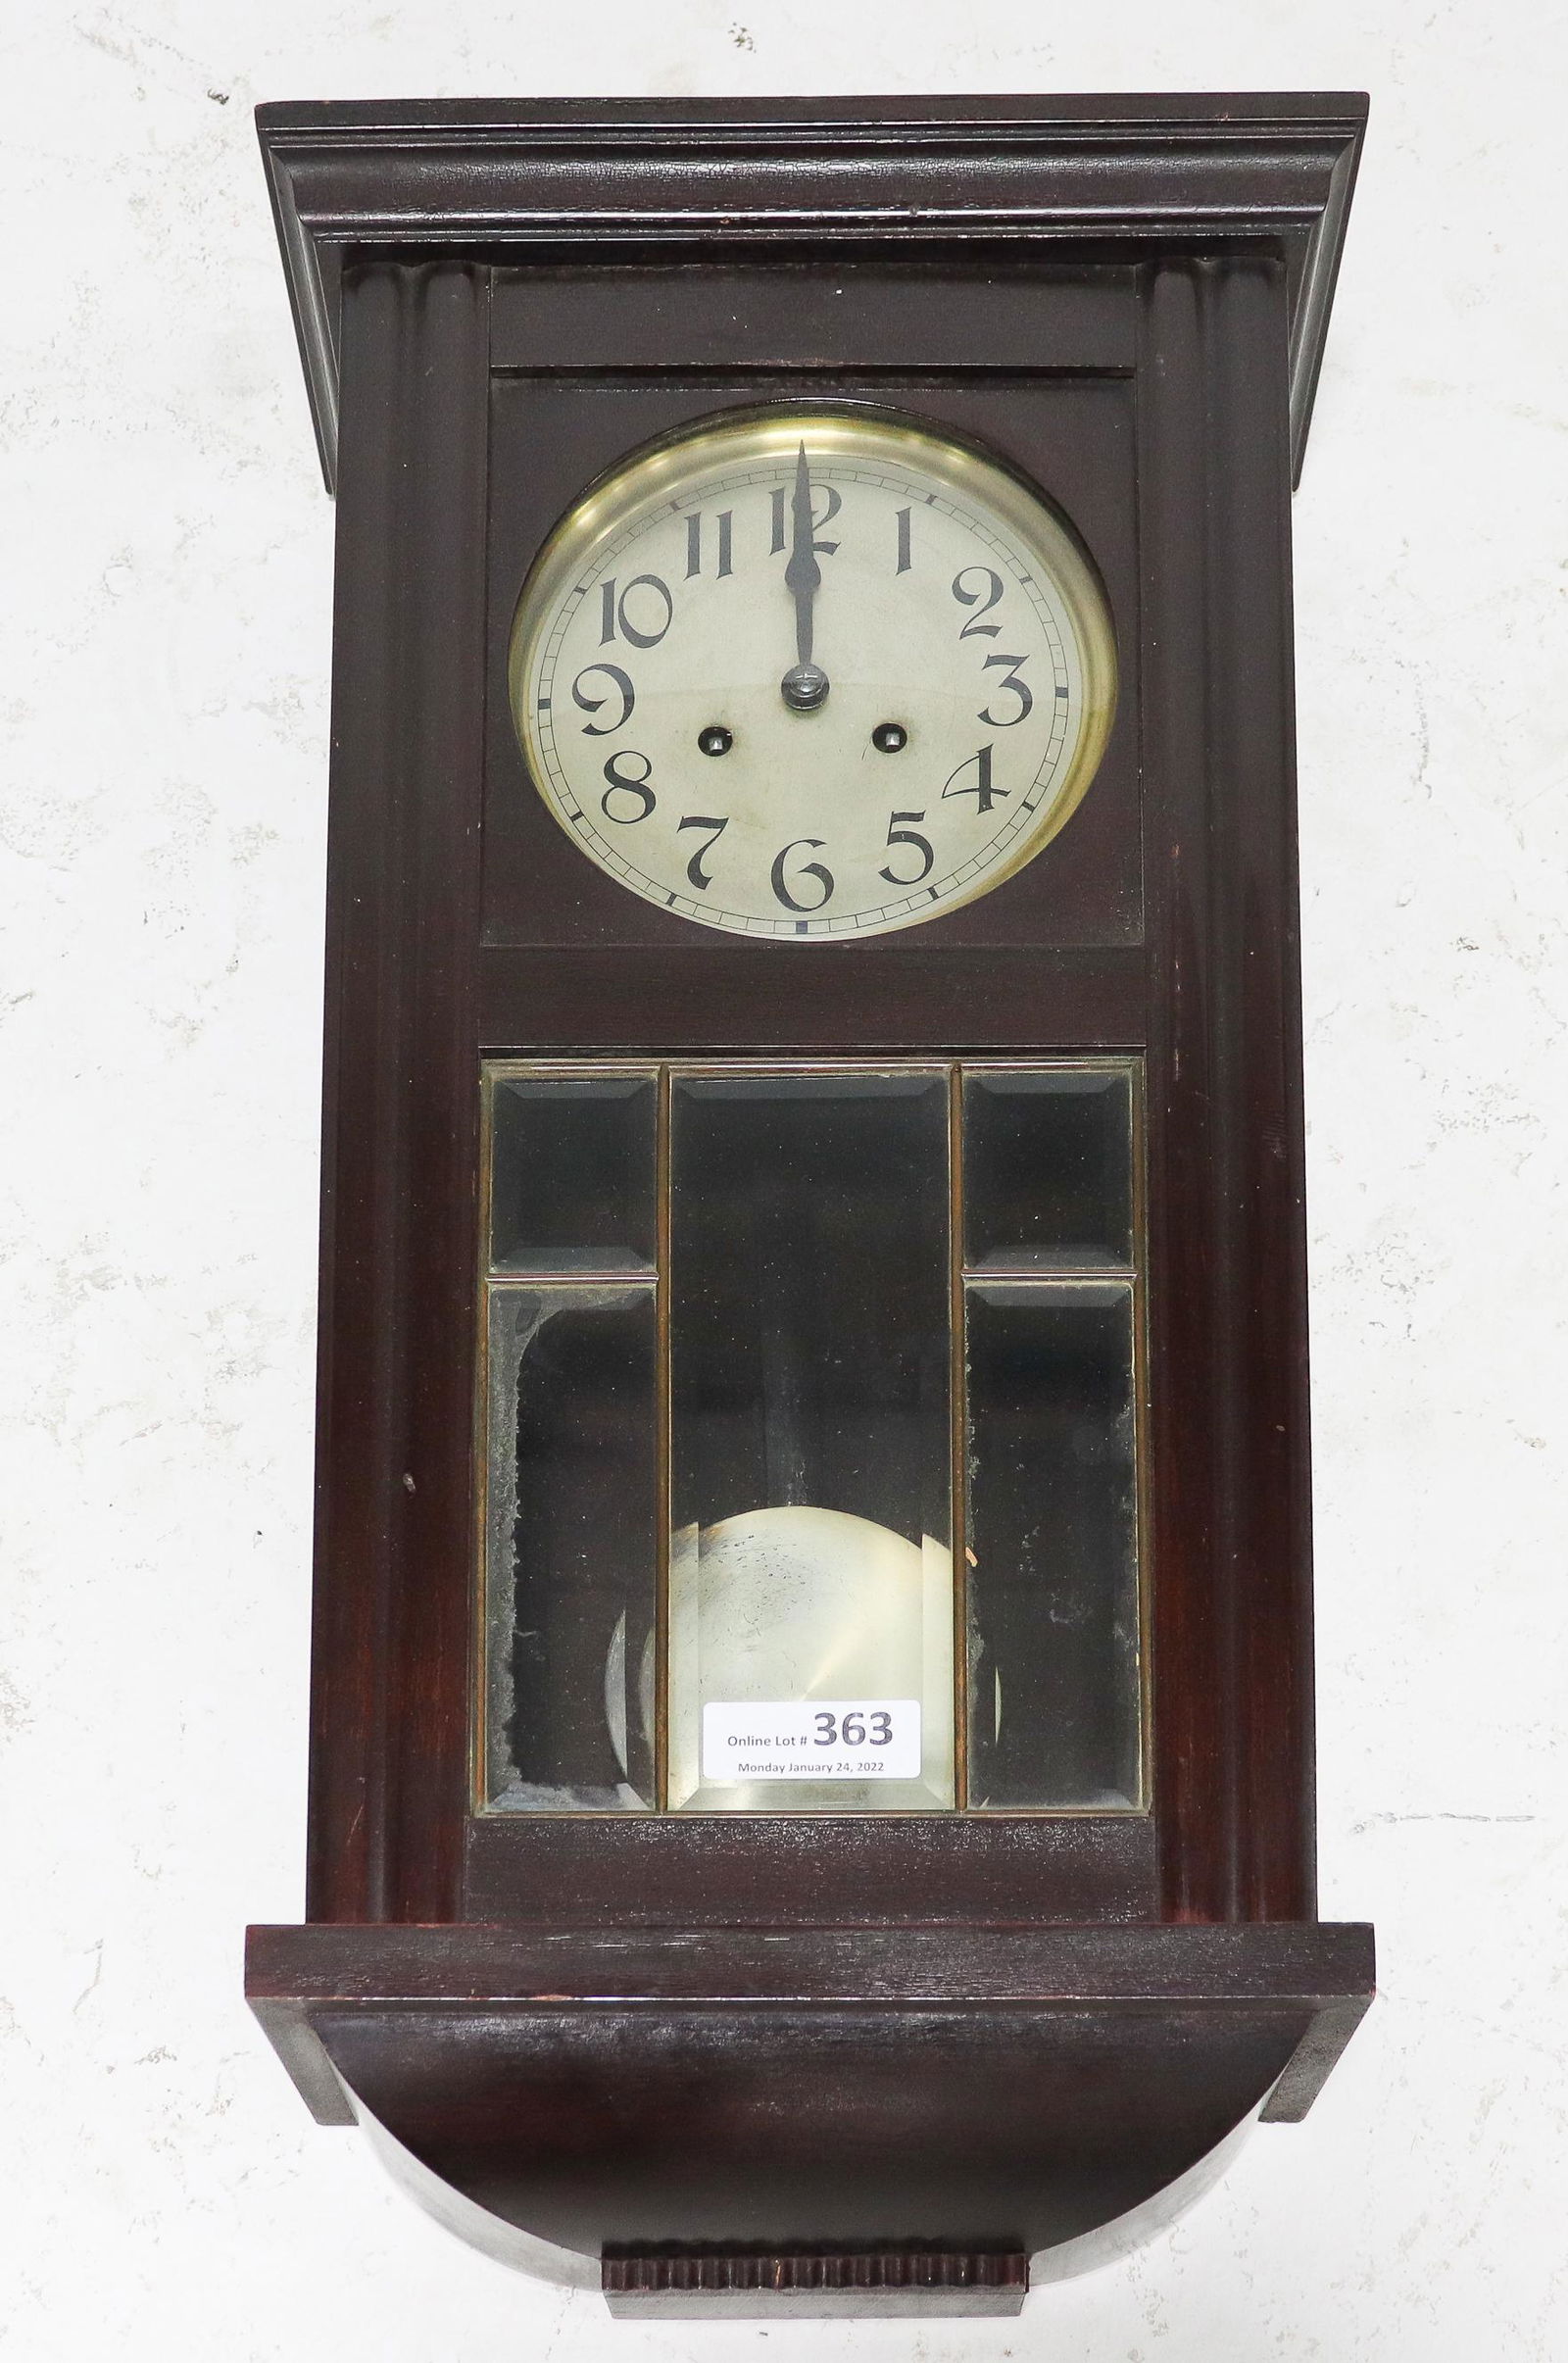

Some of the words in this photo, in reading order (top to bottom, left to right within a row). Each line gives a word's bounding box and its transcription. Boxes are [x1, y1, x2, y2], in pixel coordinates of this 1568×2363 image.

[684, 508, 734, 580] 11
[769, 483, 842, 556] 12
[896, 506, 912, 576] 1
[599, 574, 673, 649] 10
[952, 566, 1004, 640] 2
[571, 664, 635, 736] 9
[977, 655, 1033, 727] 3
[601, 750, 657, 824] 8
[941, 745, 1011, 813] 4
[676, 816, 729, 891] 7
[770, 839, 835, 912] 6
[878, 811, 934, 886] 5
[727, 1736, 772, 1747] Online
[775, 1736, 796, 1747] Lot
[799, 1736, 808, 1747] #
[813, 1711, 893, 1747] 363
[738, 1762, 785, 1774] Monday
[788, 1762, 833, 1774] January
[836, 1762, 854, 1773] 24,
[857, 1762, 885, 1772] 2022
